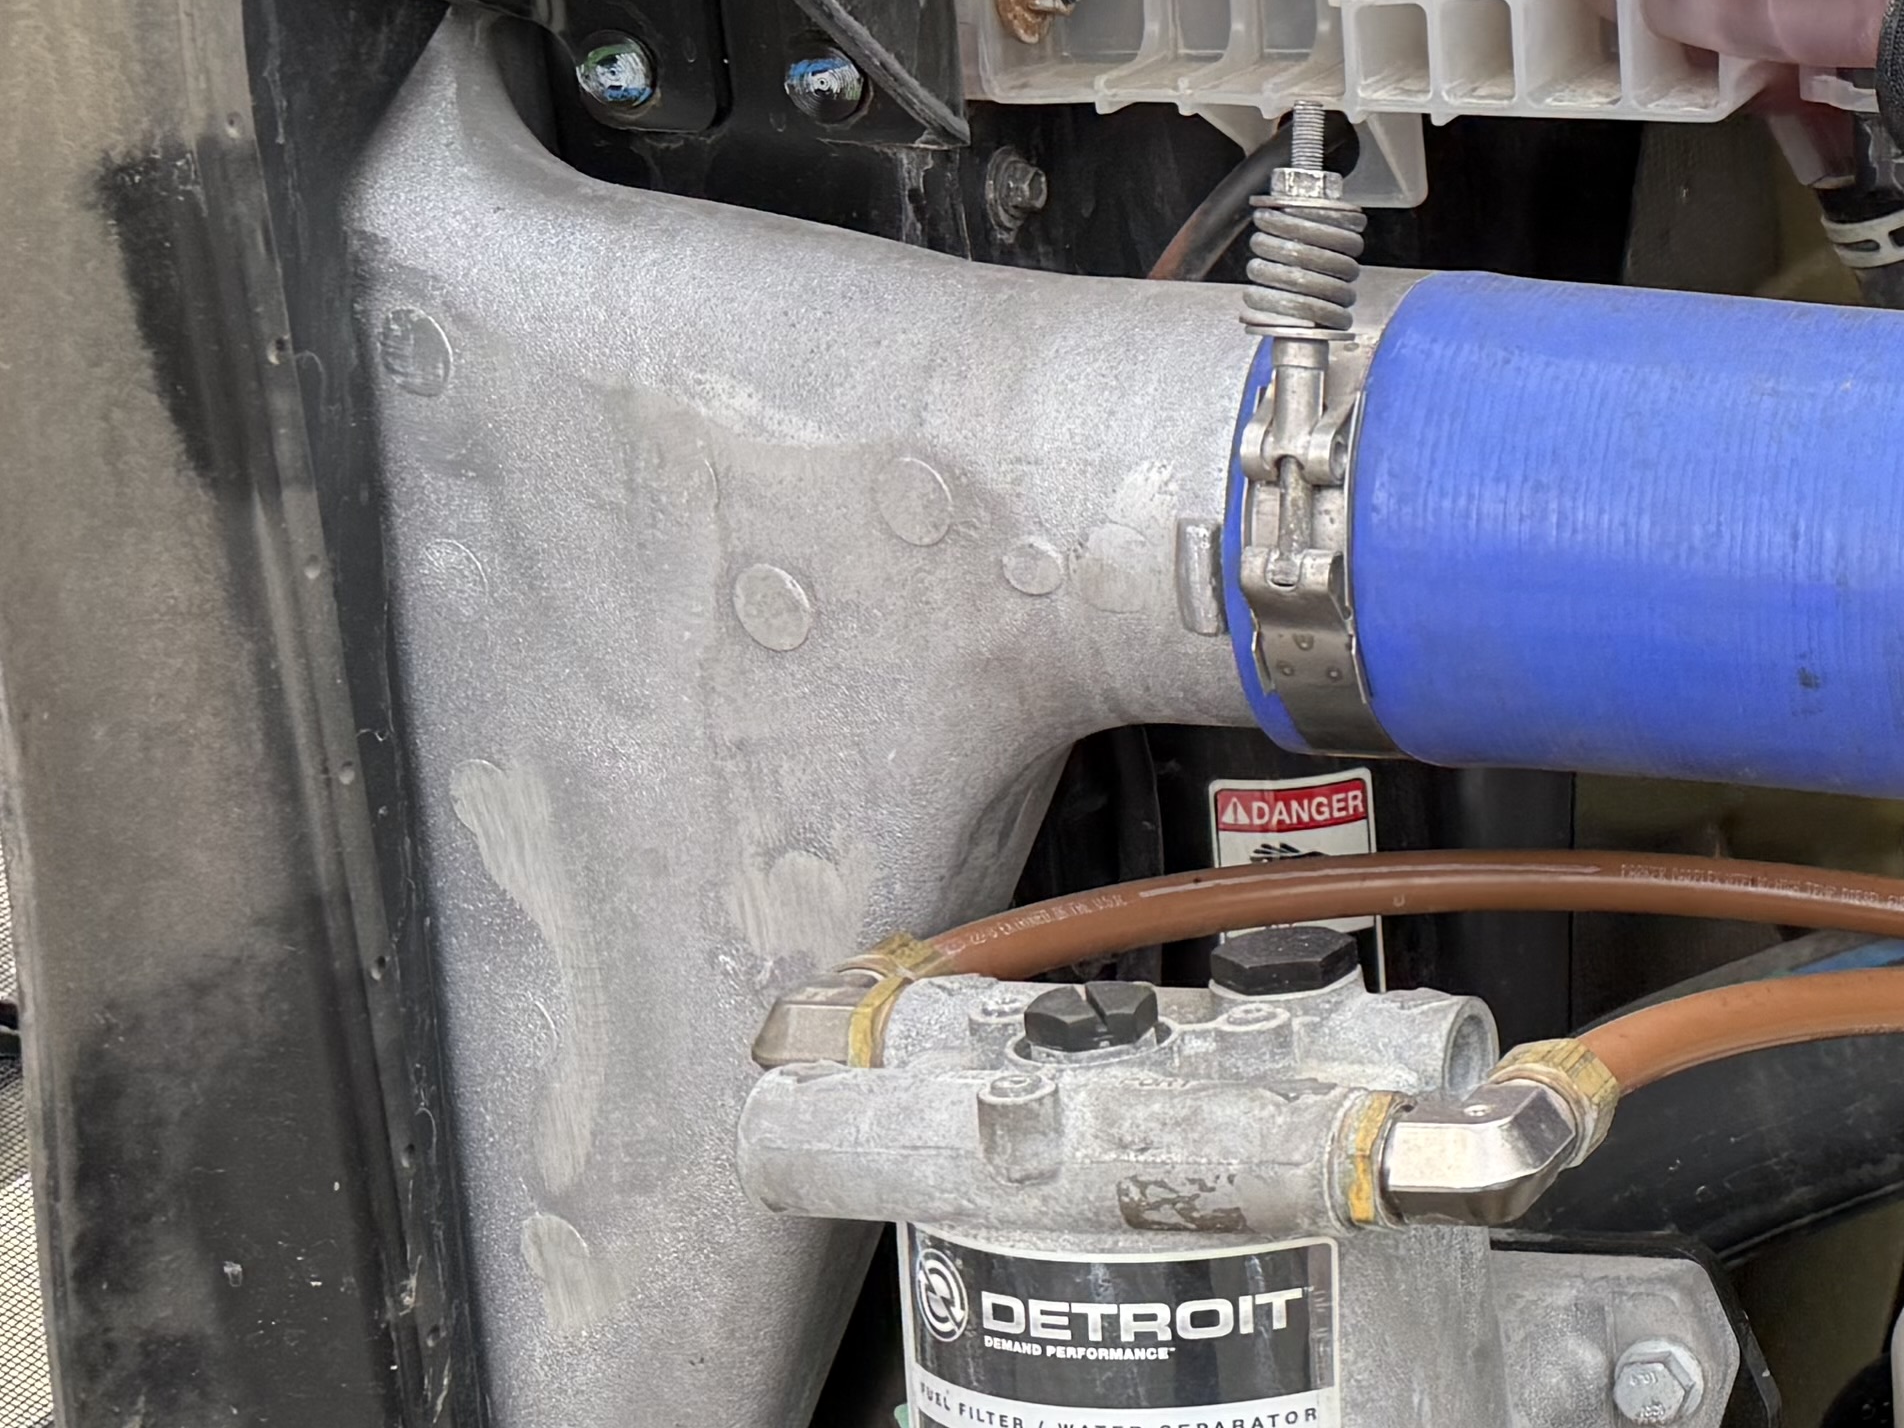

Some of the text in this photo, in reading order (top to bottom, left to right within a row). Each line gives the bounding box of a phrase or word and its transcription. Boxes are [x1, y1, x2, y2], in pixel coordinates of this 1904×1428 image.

[1252, 790, 1364, 825] DANGER
[980, 1288, 1304, 1343] DETROIT
[984, 1335, 1170, 1362] DEMAND PERFORMANCE
[920, 1382, 950, 1411] FUEL
